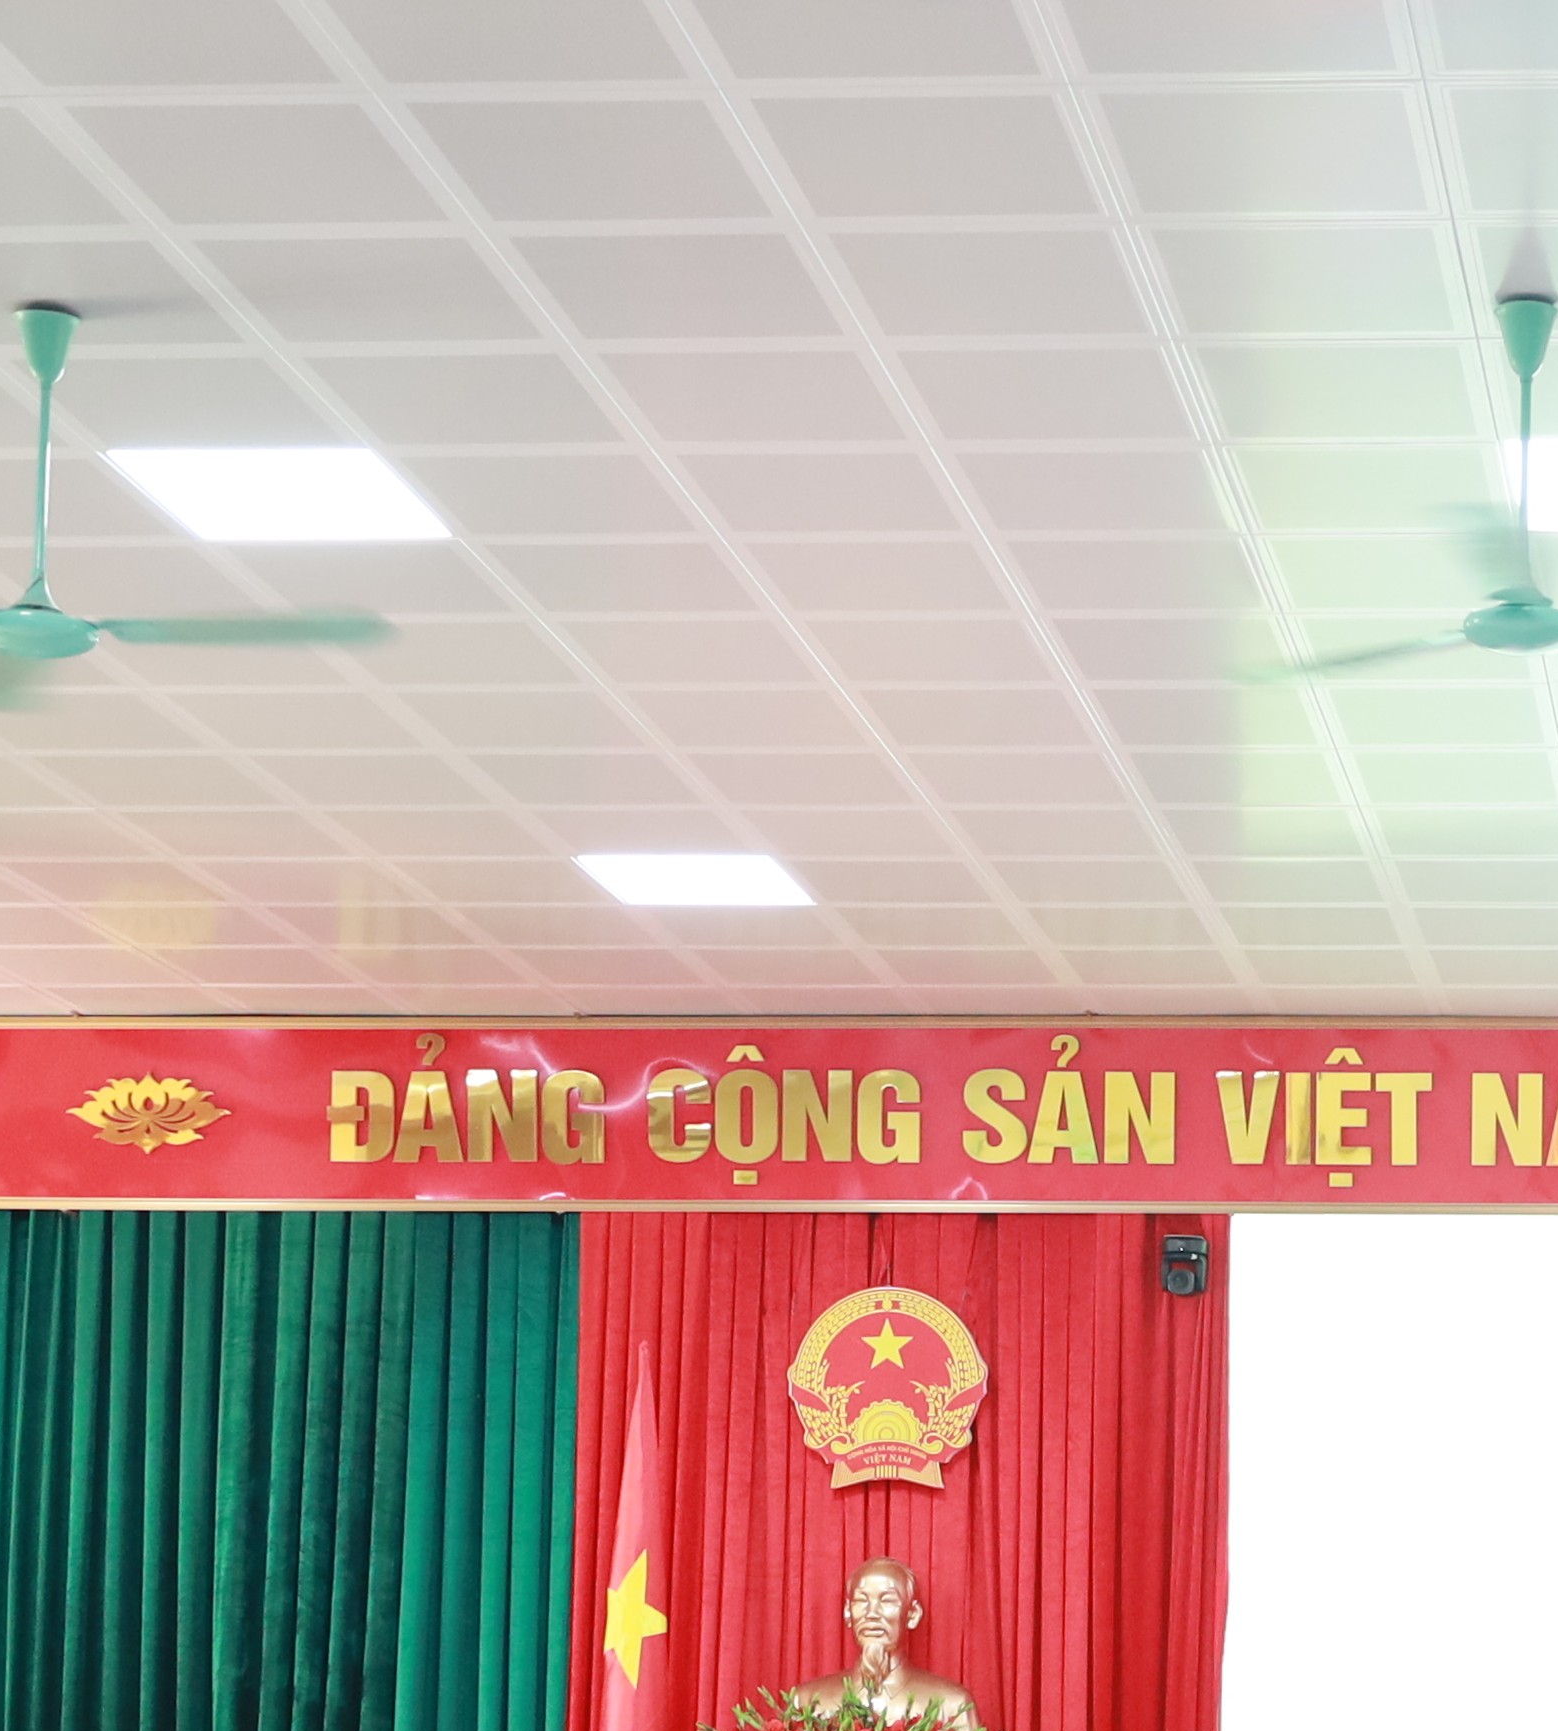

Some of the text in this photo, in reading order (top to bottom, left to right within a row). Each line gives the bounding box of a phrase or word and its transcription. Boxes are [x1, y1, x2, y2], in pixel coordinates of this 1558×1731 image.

[329, 1033, 604, 1162] ĐẢNG
[650, 1046, 921, 1184] CỘNG
[963, 1036, 1176, 1164] SẢN
[1219, 1048, 1433, 1186] VIỆT
[863, 1453, 912, 1465] VIỆT NAM
